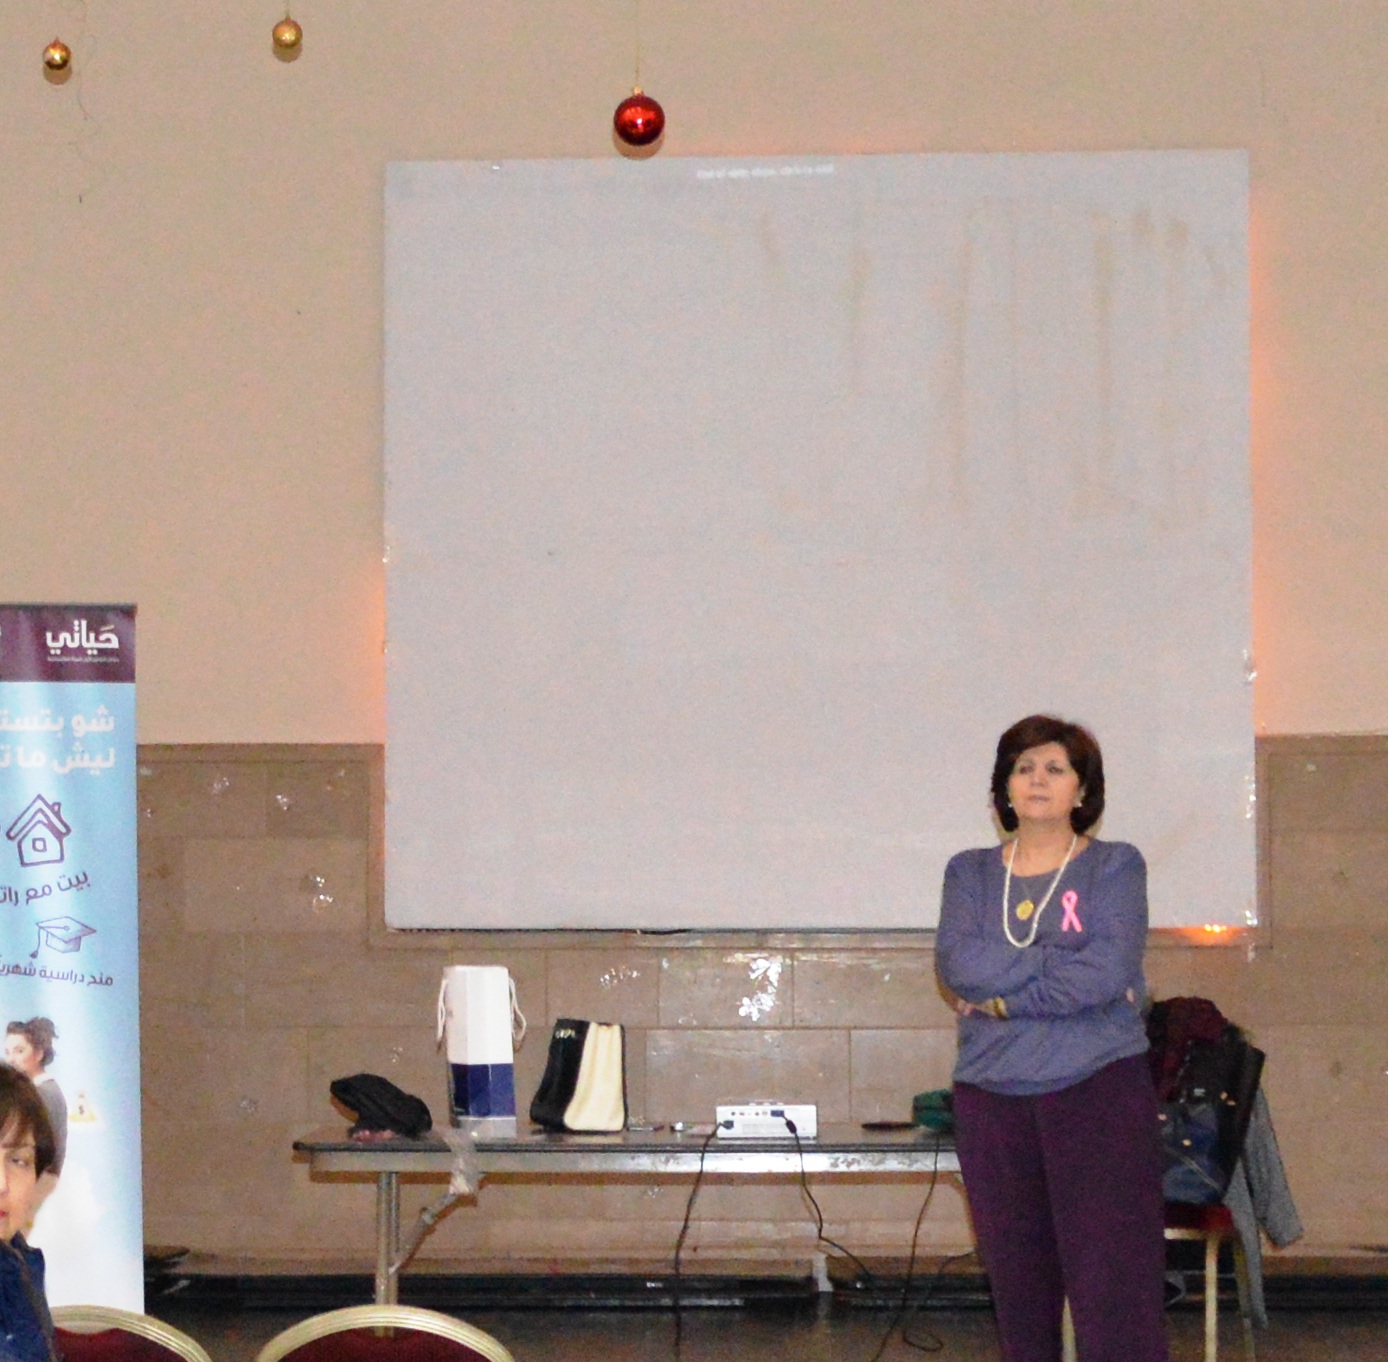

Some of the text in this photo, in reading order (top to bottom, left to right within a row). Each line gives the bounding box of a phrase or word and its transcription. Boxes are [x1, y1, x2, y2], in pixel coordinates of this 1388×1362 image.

[71, 705, 115, 738] شو
[17, 745, 46, 768] ما
[52, 742, 115, 776] ليش
[57, 871, 91, 892] بيت
[25, 884, 52, 905] مع
[39, 966, 85, 984] دراسية
[87, 972, 113, 986] منح
